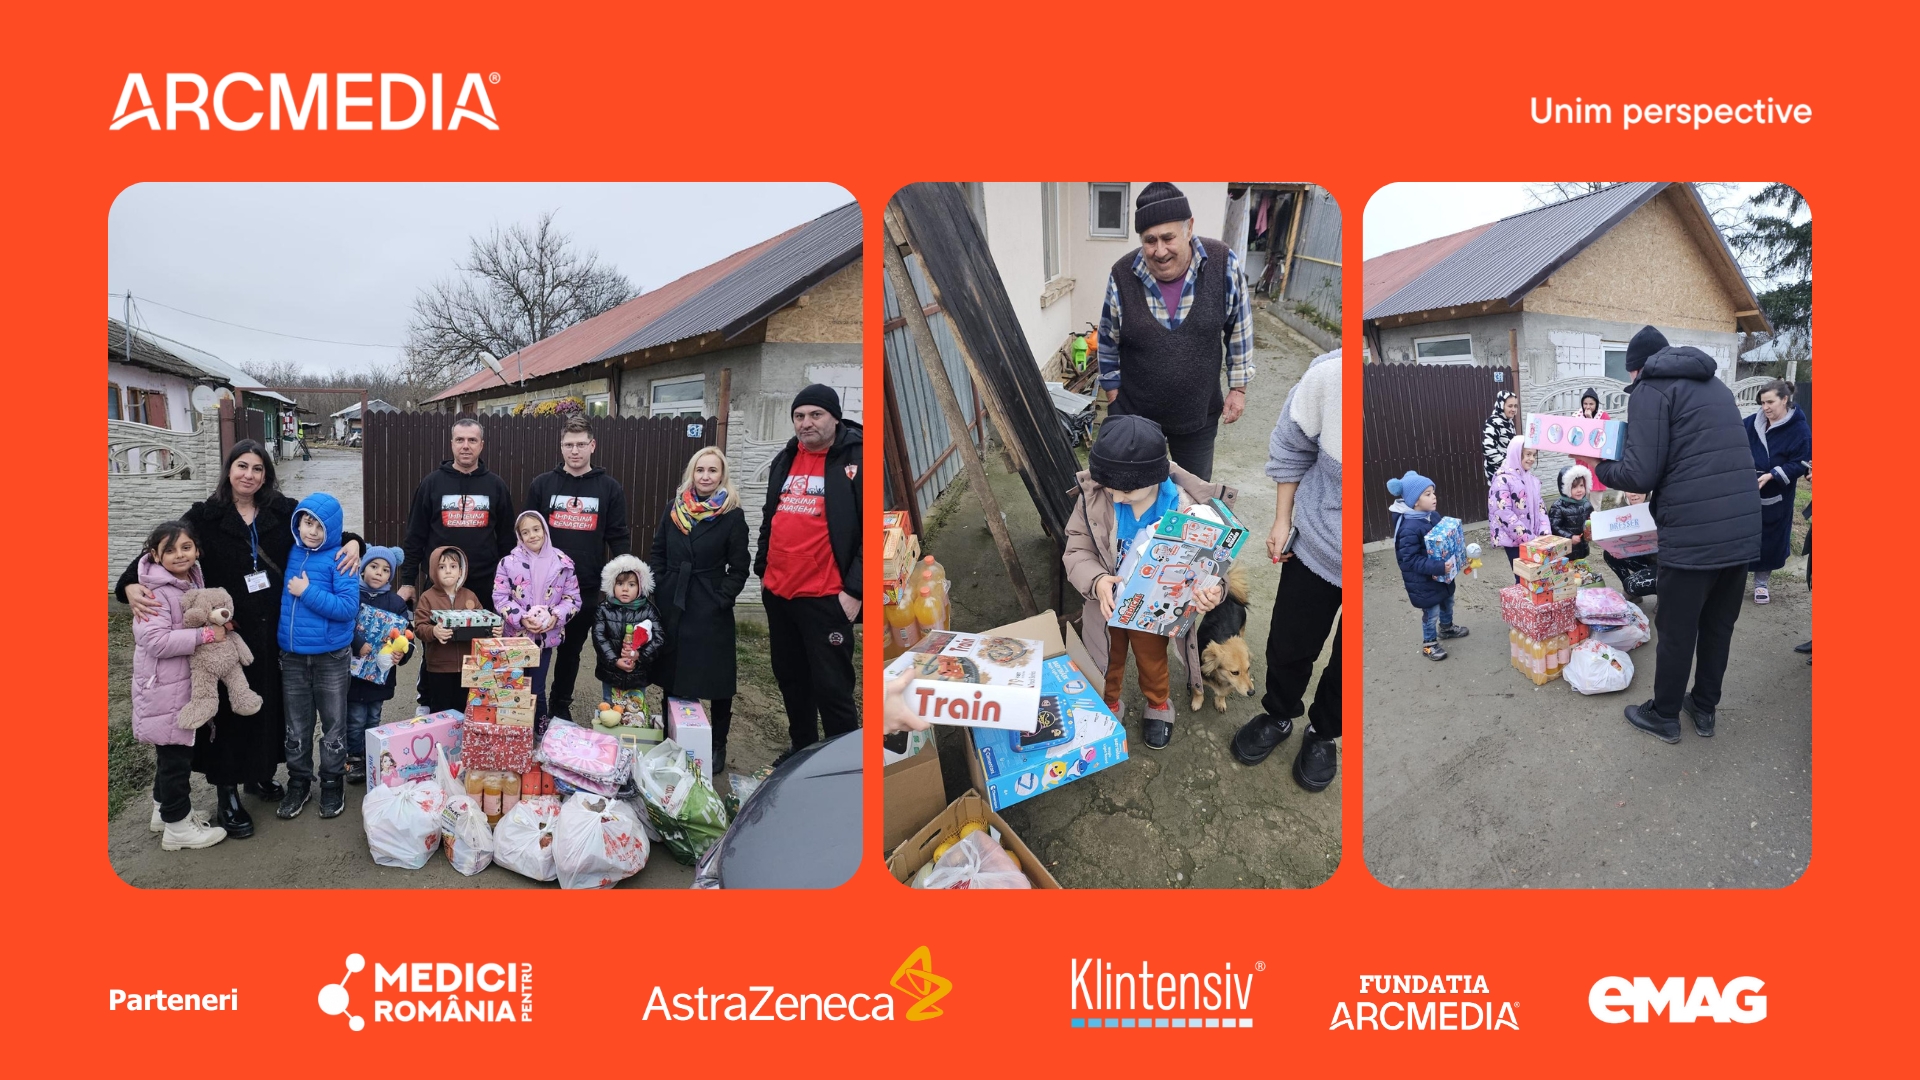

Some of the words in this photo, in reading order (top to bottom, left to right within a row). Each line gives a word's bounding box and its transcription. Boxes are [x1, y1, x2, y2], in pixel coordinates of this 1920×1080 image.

[1609, 519, 1639, 530] DRESSER
[1119, 593, 1144, 625] MEDICAL
[949, 638, 976, 653] Train
[915, 686, 1002, 722] Train
